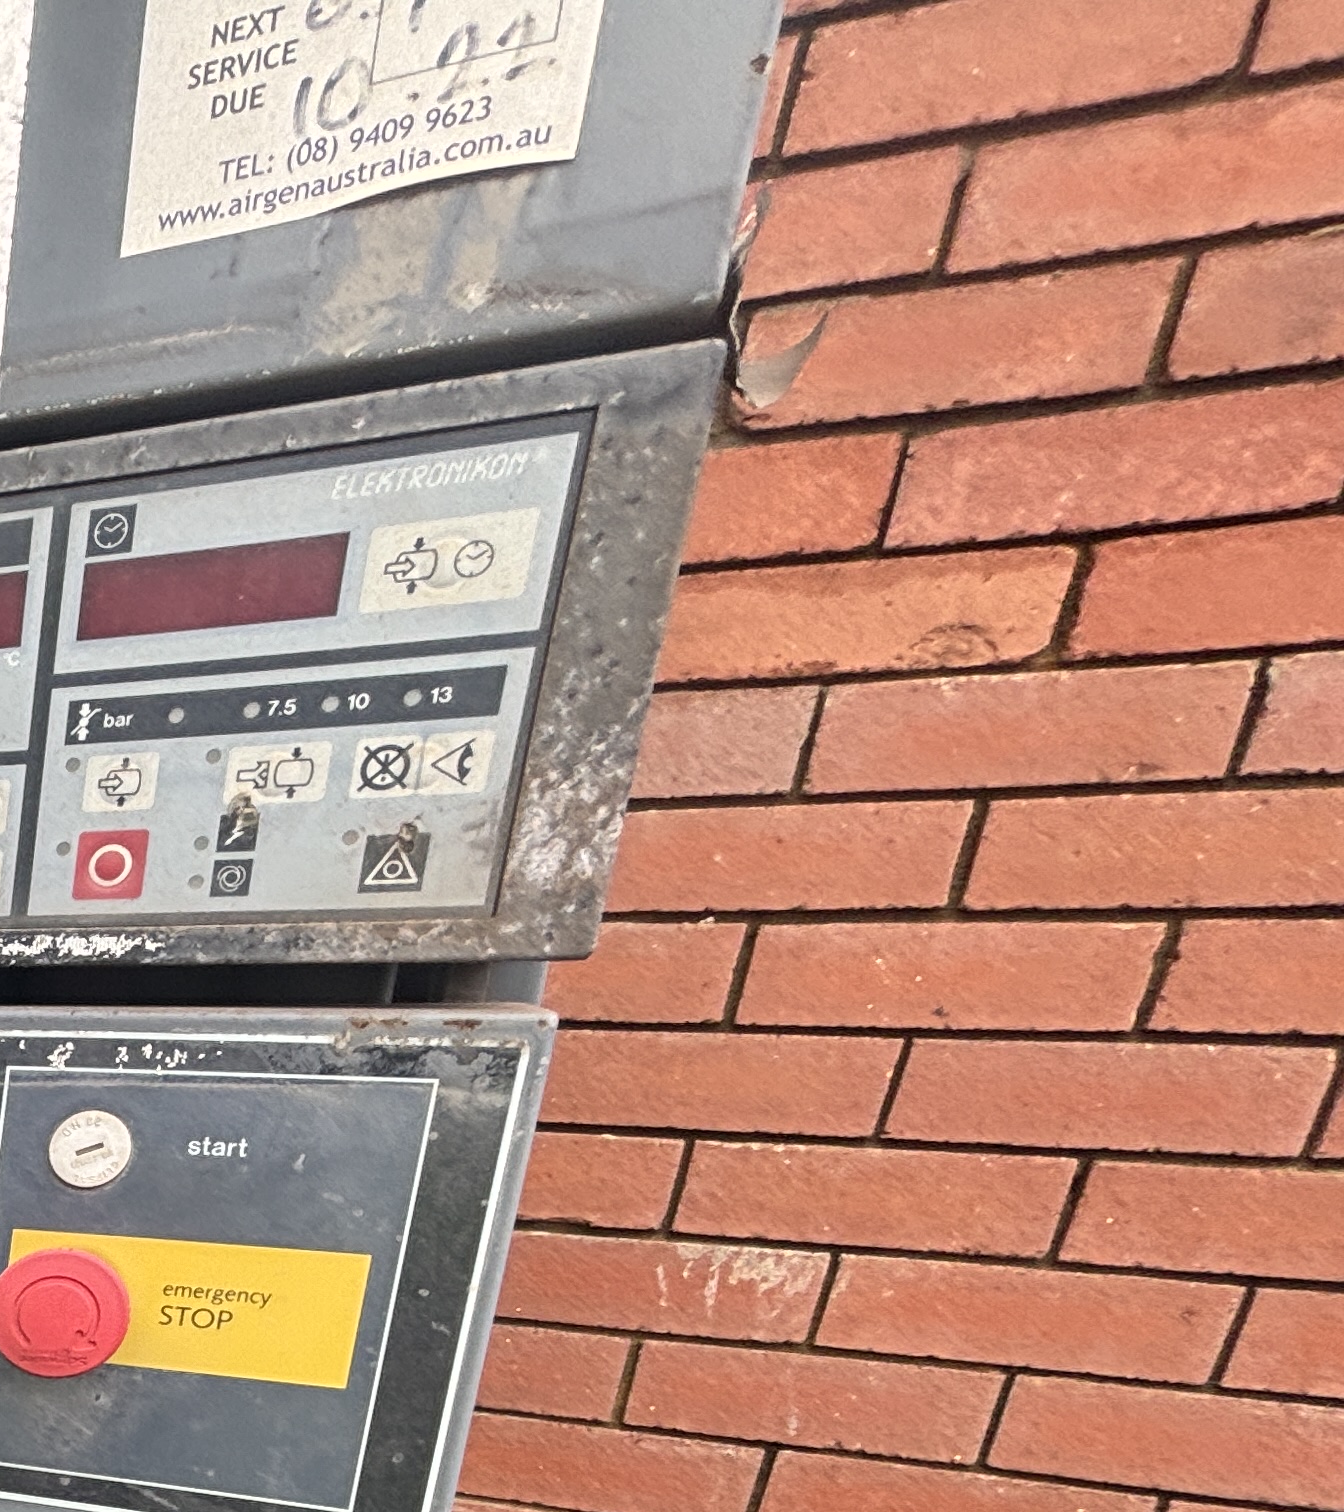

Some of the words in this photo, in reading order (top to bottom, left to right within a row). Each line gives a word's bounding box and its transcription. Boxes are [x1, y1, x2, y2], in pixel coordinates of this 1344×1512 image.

[211, 5, 285, 48] NEXT
[187, 38, 299, 90] SERVICE
[211, 83, 267, 120] DUE
[219, 154, 275, 185] TEL:
[287, 136, 339, 174] (08)
[349, 115, 414, 152] 9409
[426, 96, 493, 132] 9623
[158, 126, 553, 232] www.airgenaustralia.com.au
[104, 709, 135, 730] bar
[267, 697, 298, 717] 7.5
[347, 692, 371, 712] 10
[430, 685, 454, 705] 13
[186, 1135, 249, 1159] start
[161, 1280, 273, 1310] emergency
[158, 1304, 235, 1331] STOP
